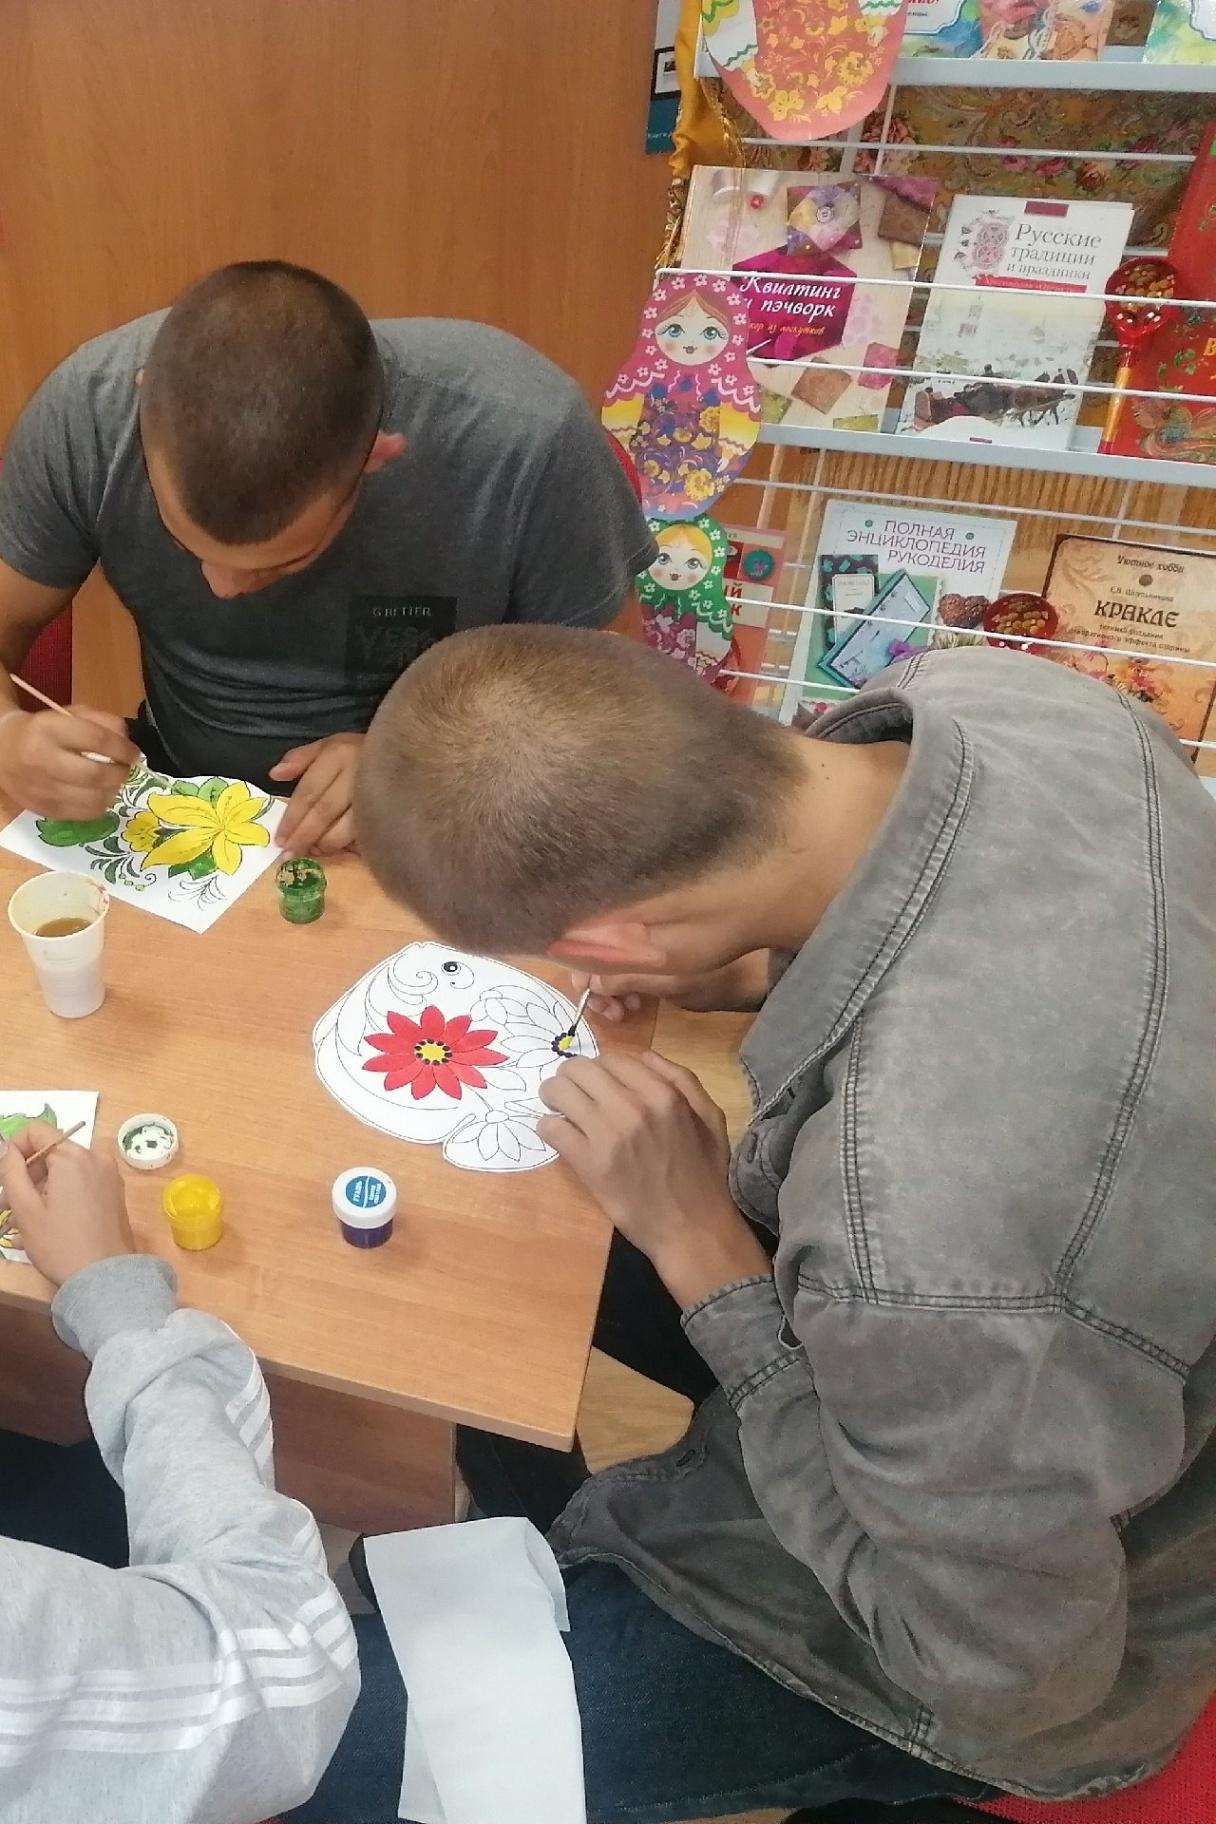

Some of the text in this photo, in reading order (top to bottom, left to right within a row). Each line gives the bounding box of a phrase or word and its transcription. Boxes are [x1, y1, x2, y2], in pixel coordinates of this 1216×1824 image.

[1015, 223, 1102, 249] Русские
[1010, 247, 1096, 266] традиции
[1006, 263, 1091, 280] и праздники
[740, 274, 841, 299] Квилтинг
[760, 299, 836, 323] пэчворк
[884, 519, 956, 541] ПОЛНАЯ
[846, 529, 986, 559] ЭНЦИКЛОПЕДИЯ
[887, 549, 987, 574] РУКОДЕЛИЯ
[1117, 554, 1185, 574] Уютное хобби
[1094, 599, 1181, 628] КРАКЛЕ
